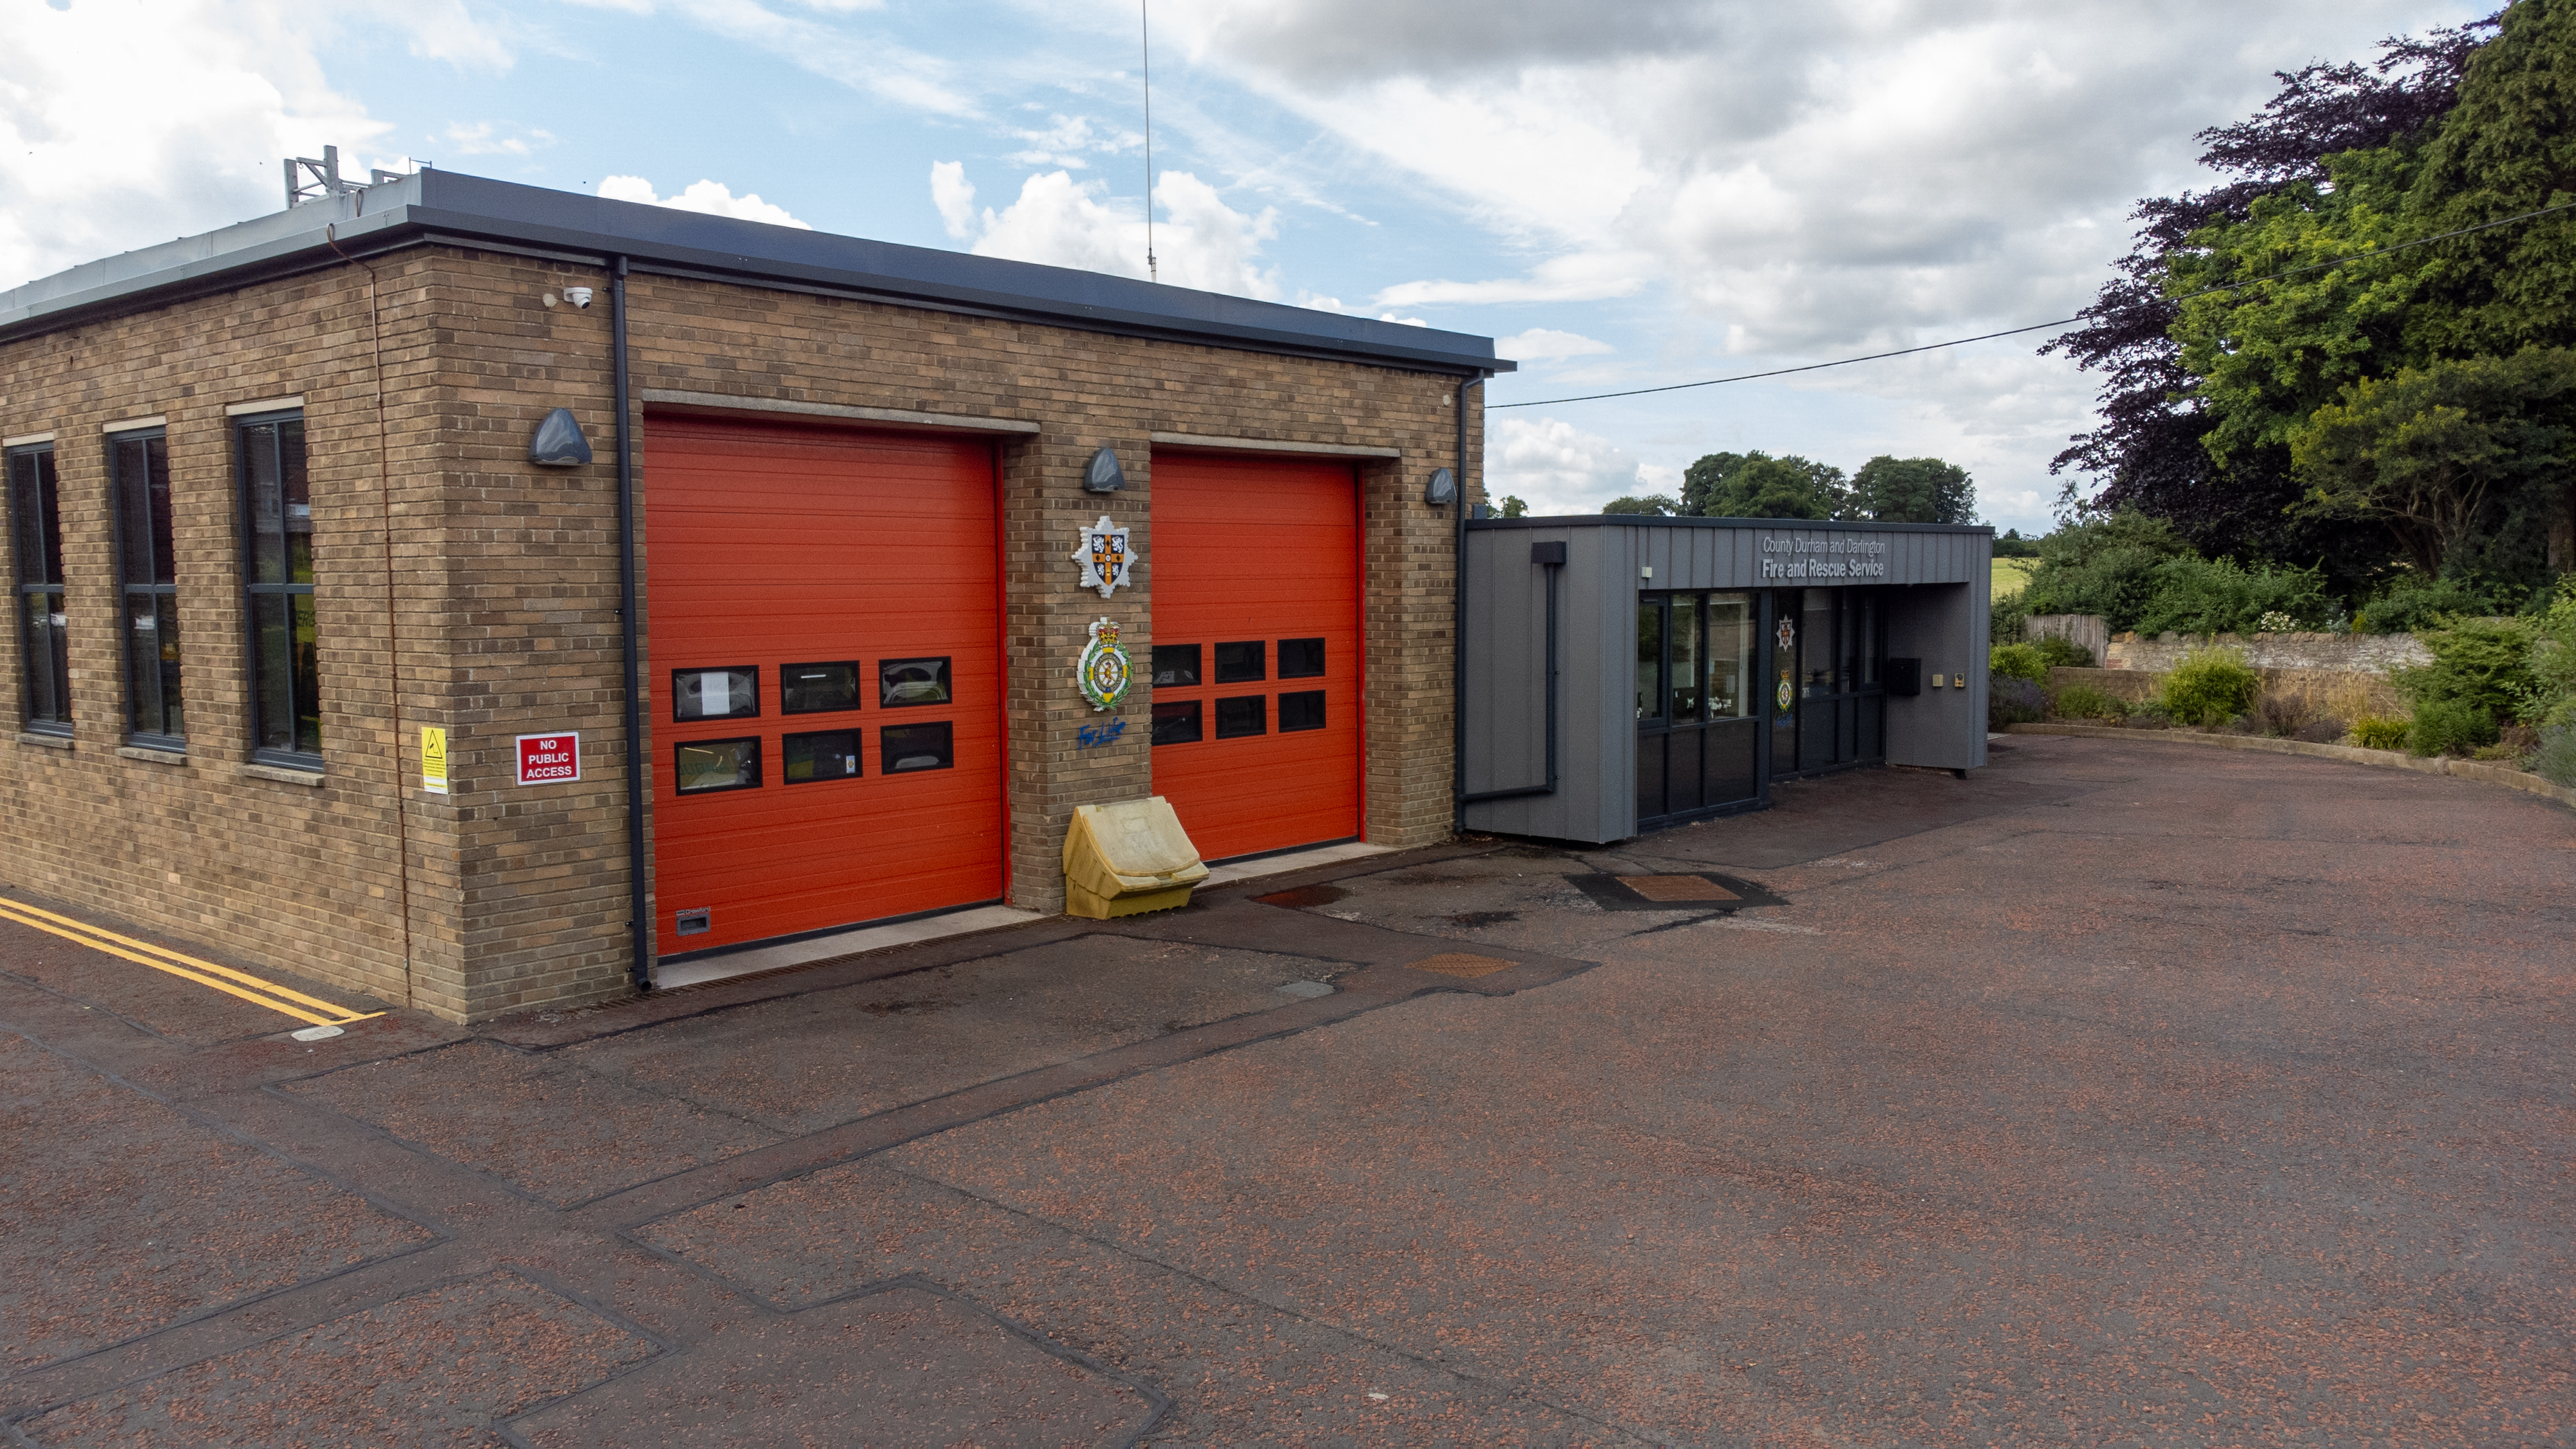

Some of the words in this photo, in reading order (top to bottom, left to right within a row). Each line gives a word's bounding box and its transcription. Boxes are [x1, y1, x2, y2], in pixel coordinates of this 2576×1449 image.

[1763, 537, 1794, 556] County
[1795, 538, 1828, 554] Durham
[1830, 539, 1845, 554] and
[1848, 538, 1885, 557] Darlington
[1763, 559, 1784, 578] Fire
[1787, 559, 1806, 578] and
[1809, 559, 1846, 577] Rescue
[1849, 559, 1884, 576] Service
[540, 740, 558, 750] NO
[529, 753, 569, 764] PUBLIC
[526, 766, 572, 779] ACCESS
